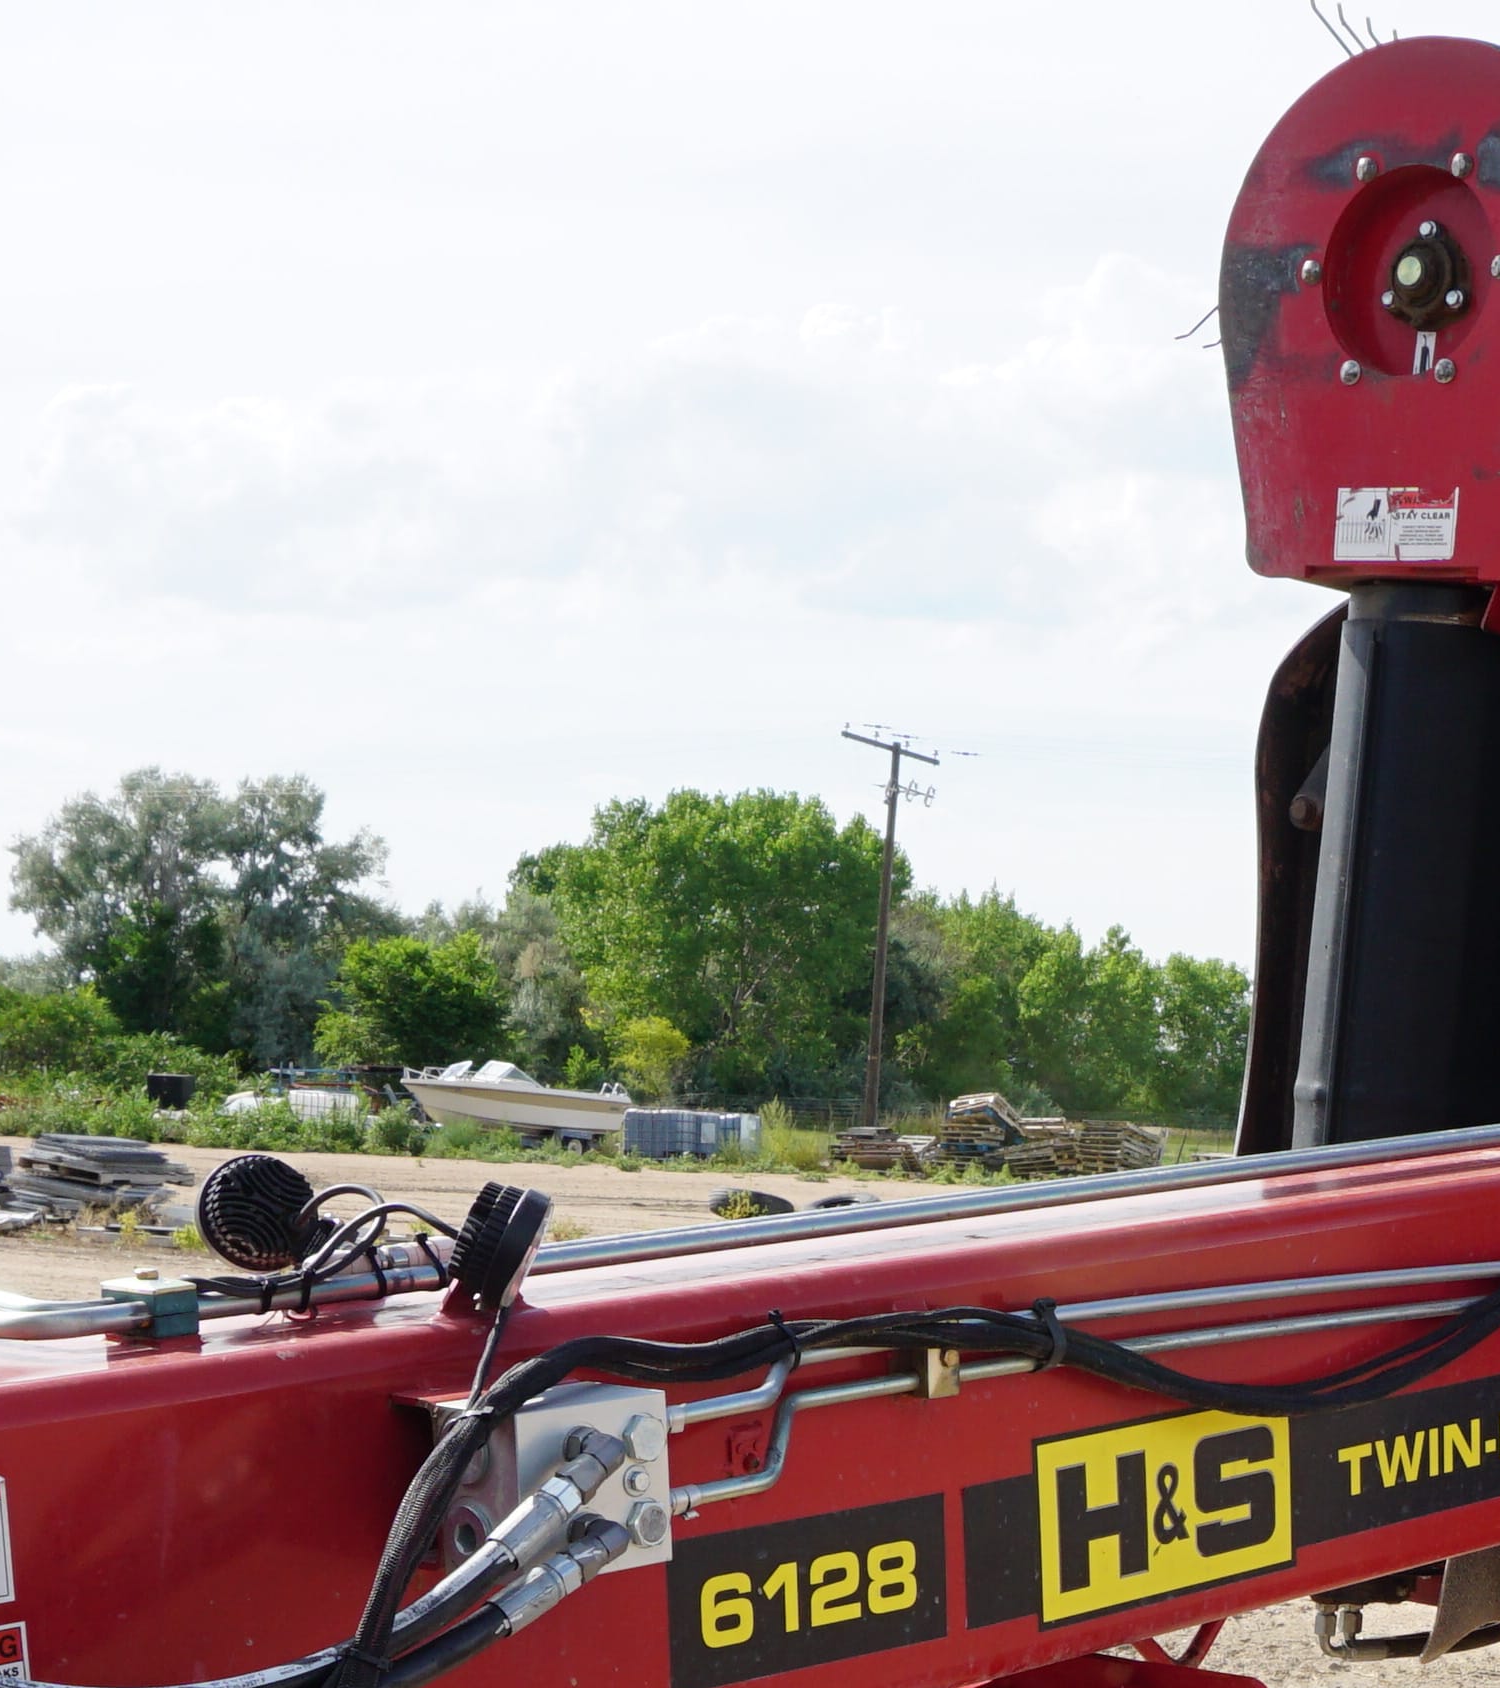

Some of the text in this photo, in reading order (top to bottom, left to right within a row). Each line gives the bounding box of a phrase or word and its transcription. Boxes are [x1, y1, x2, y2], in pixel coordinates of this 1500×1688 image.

[1396, 511, 1417, 520] STAY
[1056, 1425, 1278, 1594] H&S
[698, 1540, 919, 1650] 6128
